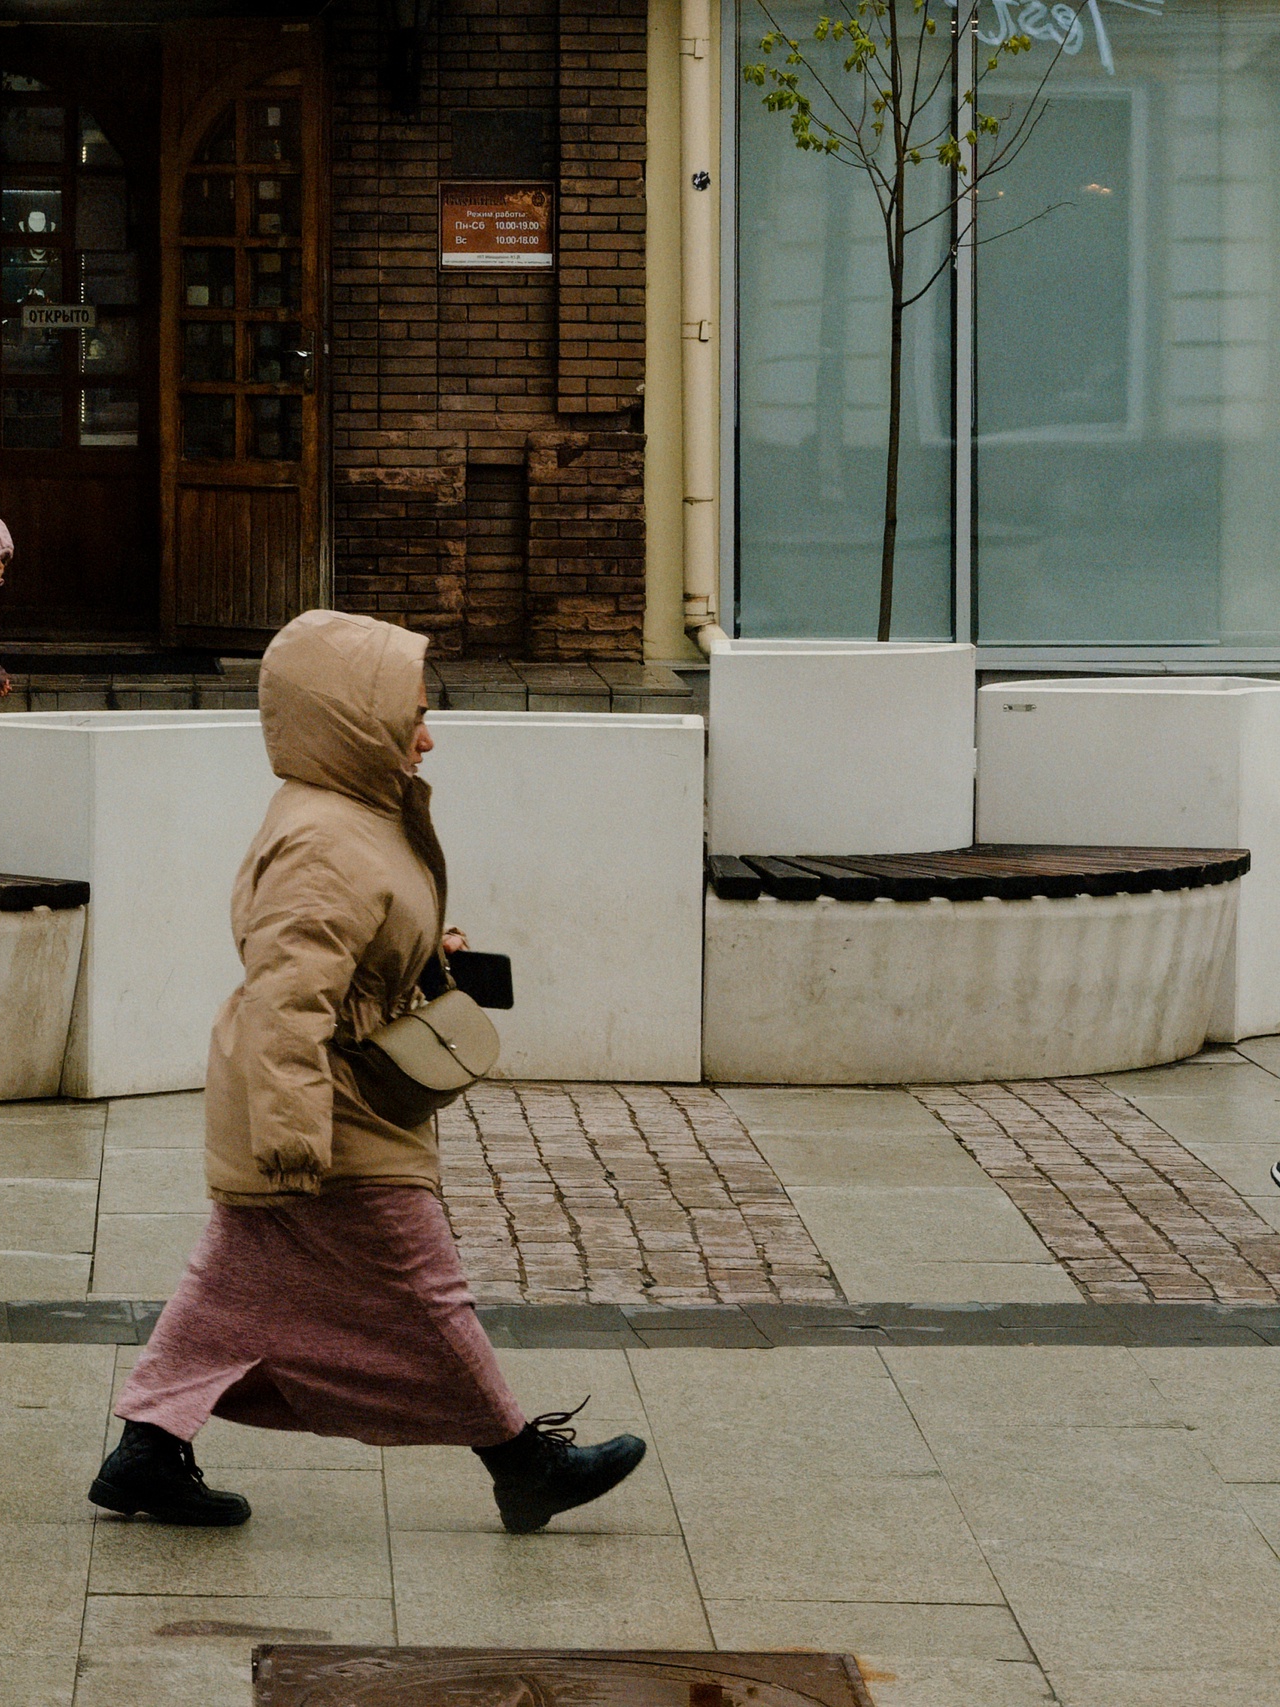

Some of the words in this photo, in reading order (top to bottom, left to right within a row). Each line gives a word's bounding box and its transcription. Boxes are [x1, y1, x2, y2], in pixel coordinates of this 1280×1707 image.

[466, 210, 493, 218] Режим
[455, 221, 486, 230] Пн-Сб
[495, 221, 539, 230] 10.00-19.00
[455, 236, 467, 245] Вс
[495, 236, 539, 245] 10.00-18.00
[29, 309, 89, 323] ОТКРЫТО
